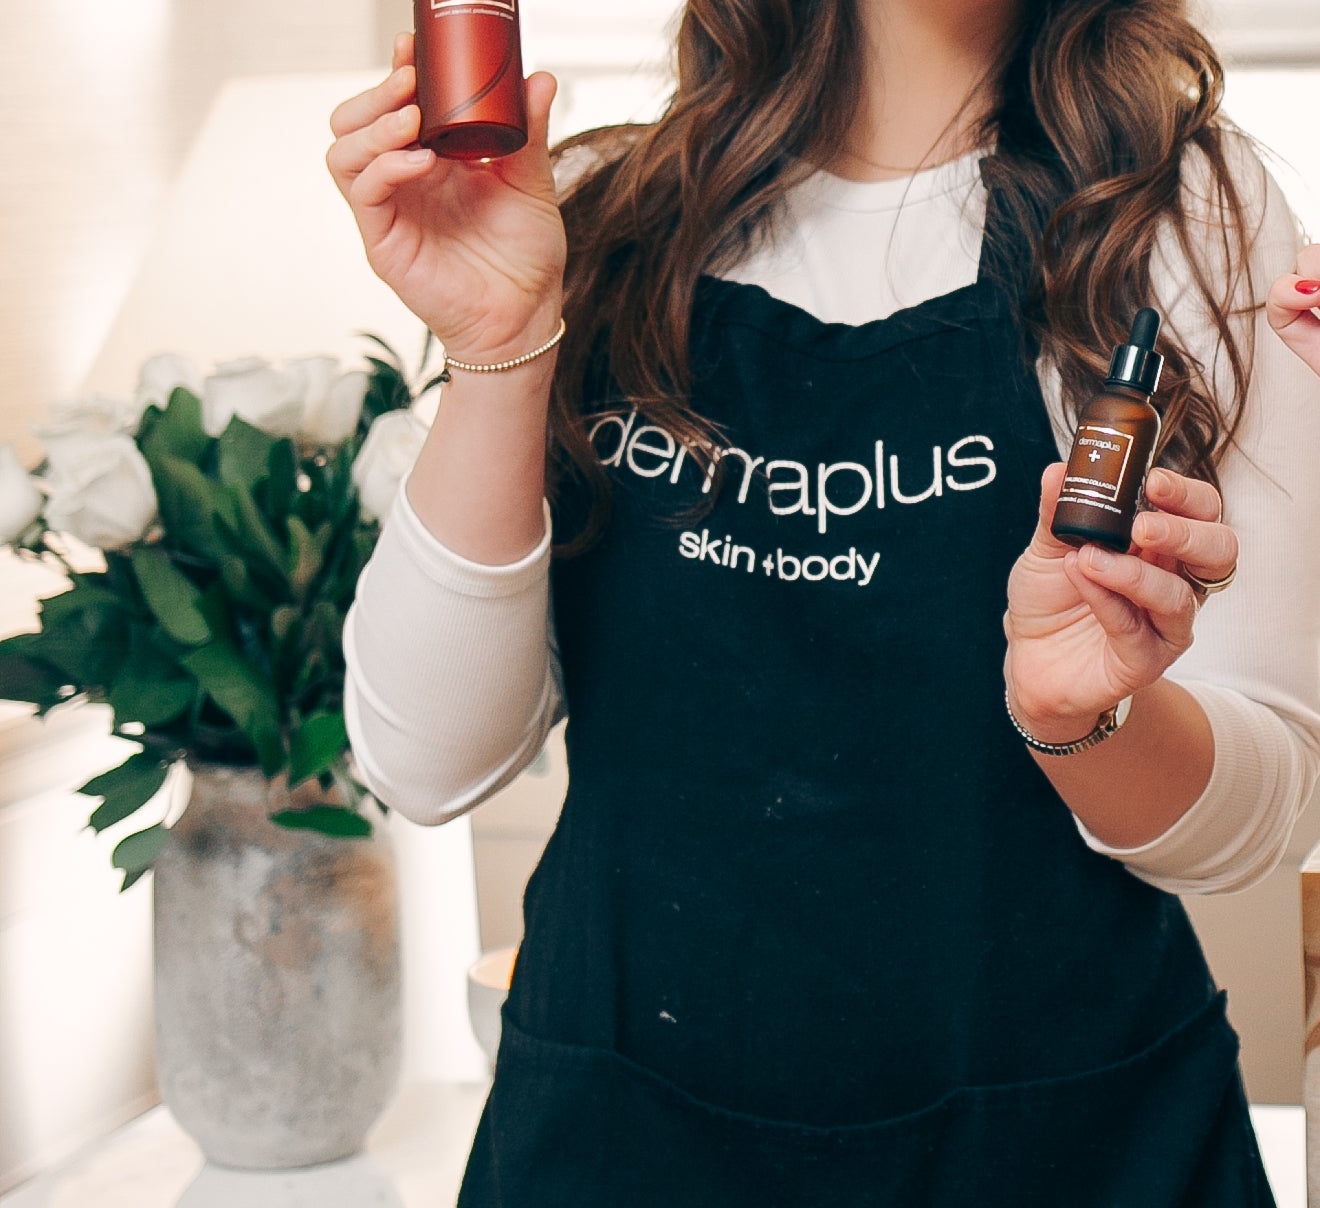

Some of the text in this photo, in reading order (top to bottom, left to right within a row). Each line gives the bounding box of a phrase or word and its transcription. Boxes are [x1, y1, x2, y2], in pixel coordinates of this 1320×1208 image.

[587, 404, 997, 534] dermaplus
[1078, 437, 1122, 452] dermaplus
[678, 528, 756, 573] skin
[777, 546, 881, 587] body
